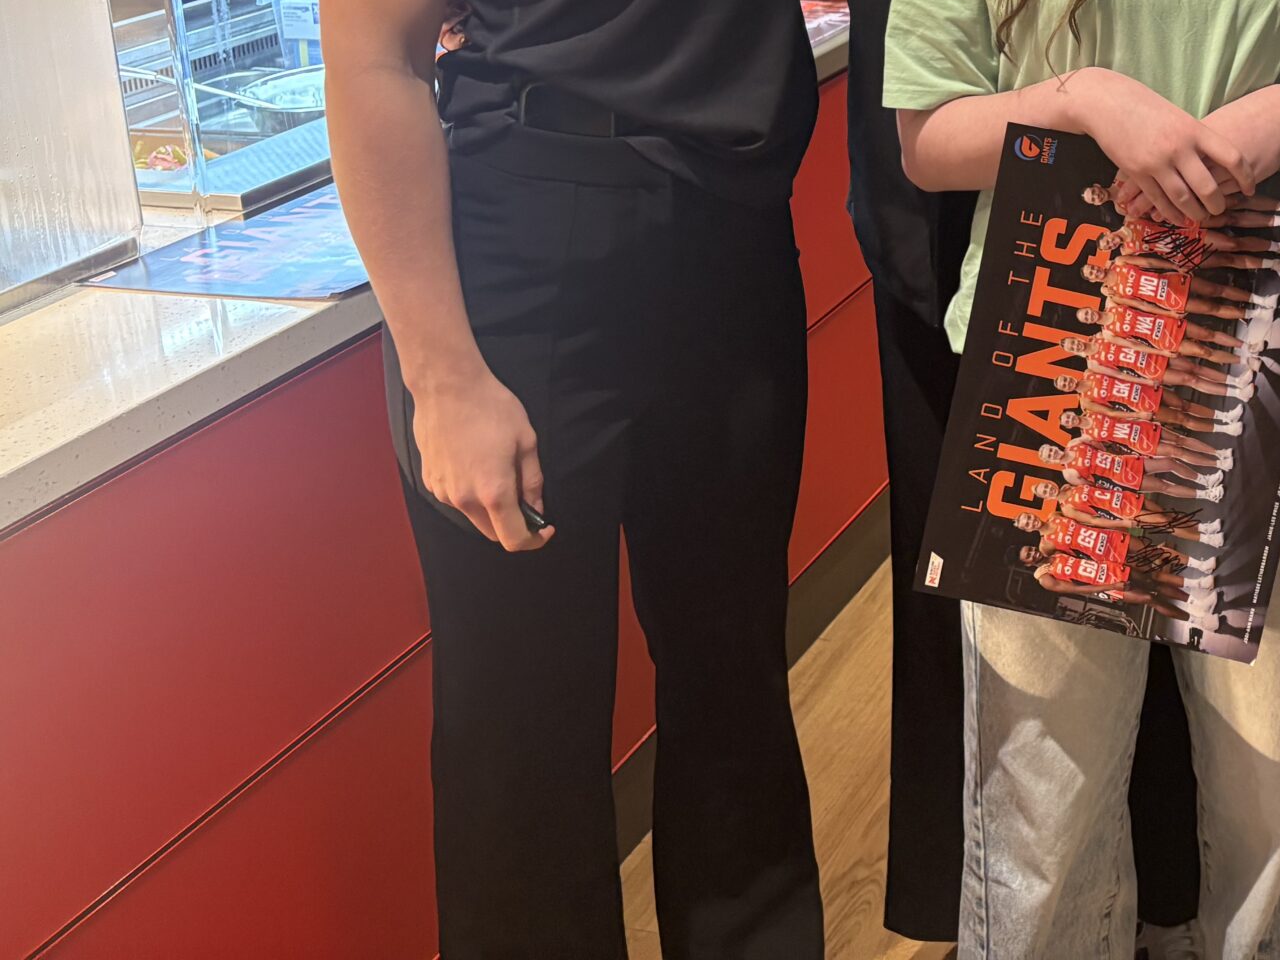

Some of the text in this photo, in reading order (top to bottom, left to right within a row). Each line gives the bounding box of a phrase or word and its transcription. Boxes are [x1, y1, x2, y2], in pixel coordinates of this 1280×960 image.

[1041, 137, 1053, 164] GIANTS
[1137, 274, 1158, 296] WD
[1134, 314, 1154, 334] WA
[961, 210, 1043, 513] LAND OF THE
[1118, 346, 1137, 363] GA
[986, 217, 1111, 520] GIANTS
[1111, 380, 1131, 397] GK
[1112, 420, 1131, 440] WA
[1076, 526, 1097, 548] GS
[1077, 557, 1098, 578] GD
